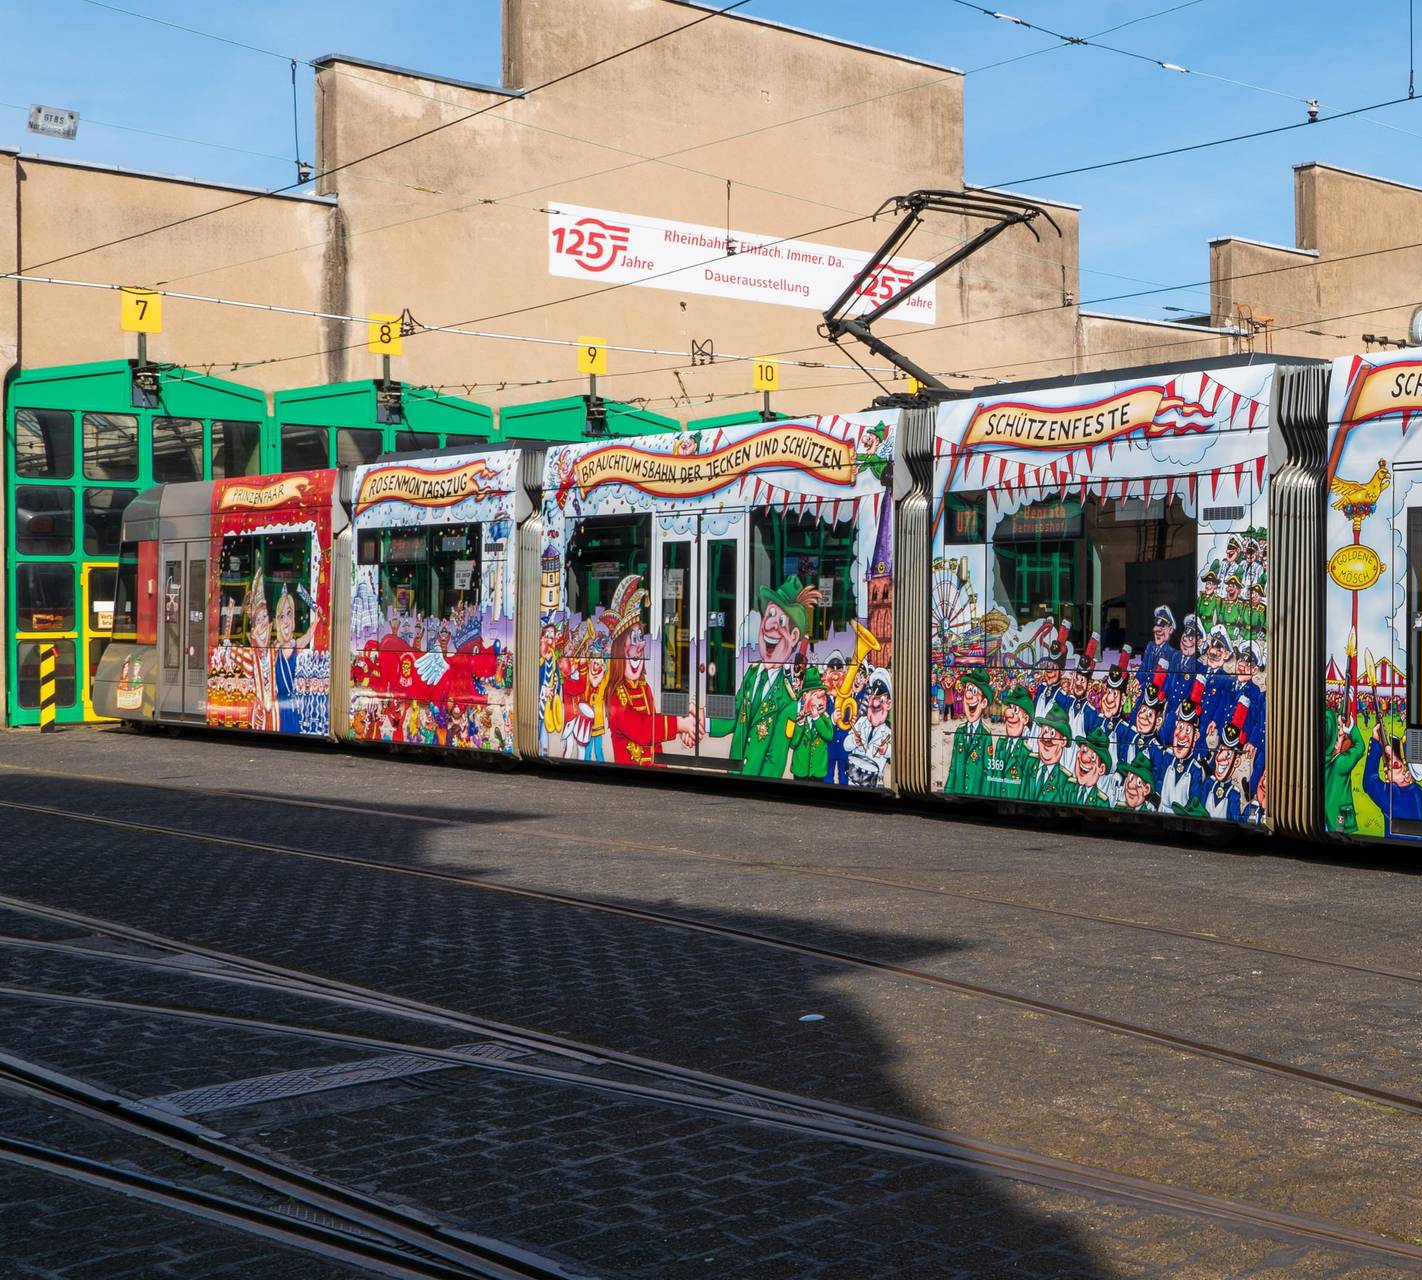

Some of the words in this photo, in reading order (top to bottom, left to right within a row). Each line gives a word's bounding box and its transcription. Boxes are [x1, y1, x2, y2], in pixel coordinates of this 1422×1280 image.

[552, 227, 604, 259] 125
[620, 255, 655, 271] Jahre
[740, 241, 784, 260] Einfach.
[787, 249, 825, 265] Immer.
[828, 255, 845, 269] Da.
[704, 269, 810, 297] Dauerausstellung
[135, 299, 148, 320] 7
[906, 295, 933, 309] Jahre
[380, 325, 391, 344] 8
[588, 346, 597, 364] 9
[758, 364, 774, 382] 10
[985, 402, 1131, 441] SCHÜTZENFESTE
[680, 463, 702, 484] DER
[706, 444, 752, 481] JECKEN
[755, 437, 779, 459] UND
[781, 435, 842, 470] SCHÜTZEN
[233, 483, 285, 505] PRINZENPAAR
[369, 472, 468, 499] ROSENMONTAGSZUG
[1336, 550, 1373, 566] GOLDENE
[1339, 569, 1370, 584] MÖSCH
[987, 758, 1004, 771] 3369
